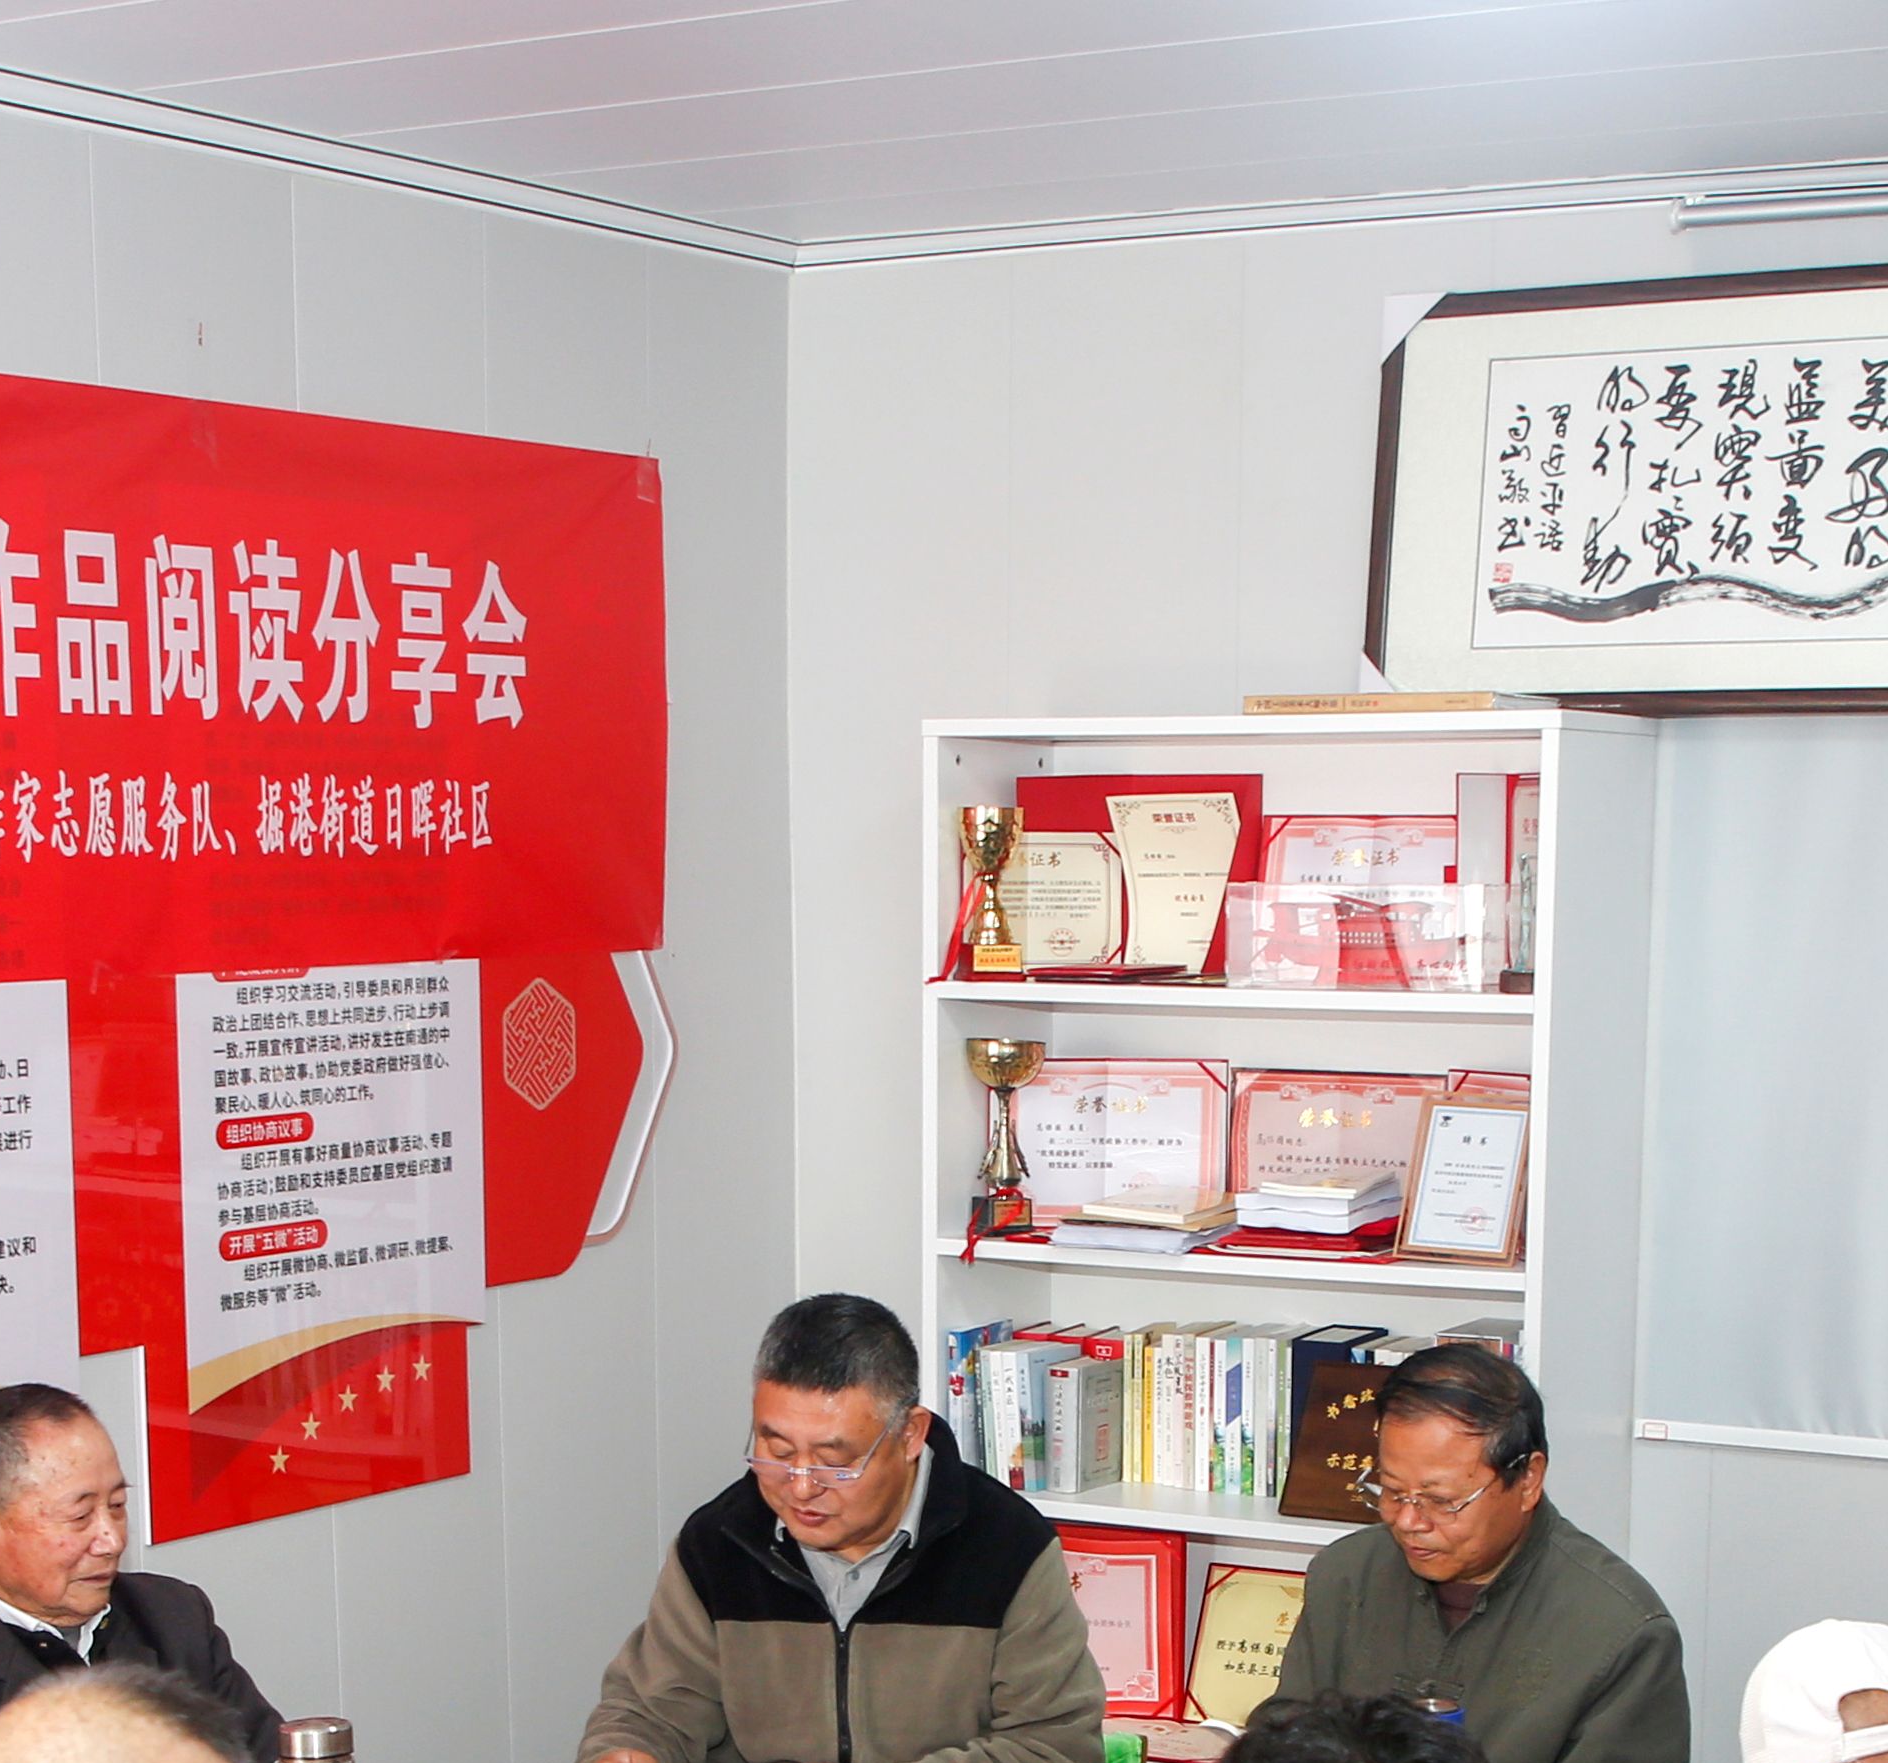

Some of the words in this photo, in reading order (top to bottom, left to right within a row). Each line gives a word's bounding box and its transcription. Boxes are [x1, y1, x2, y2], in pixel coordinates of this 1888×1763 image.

[226, 1118, 304, 1145] 组织协商议事
